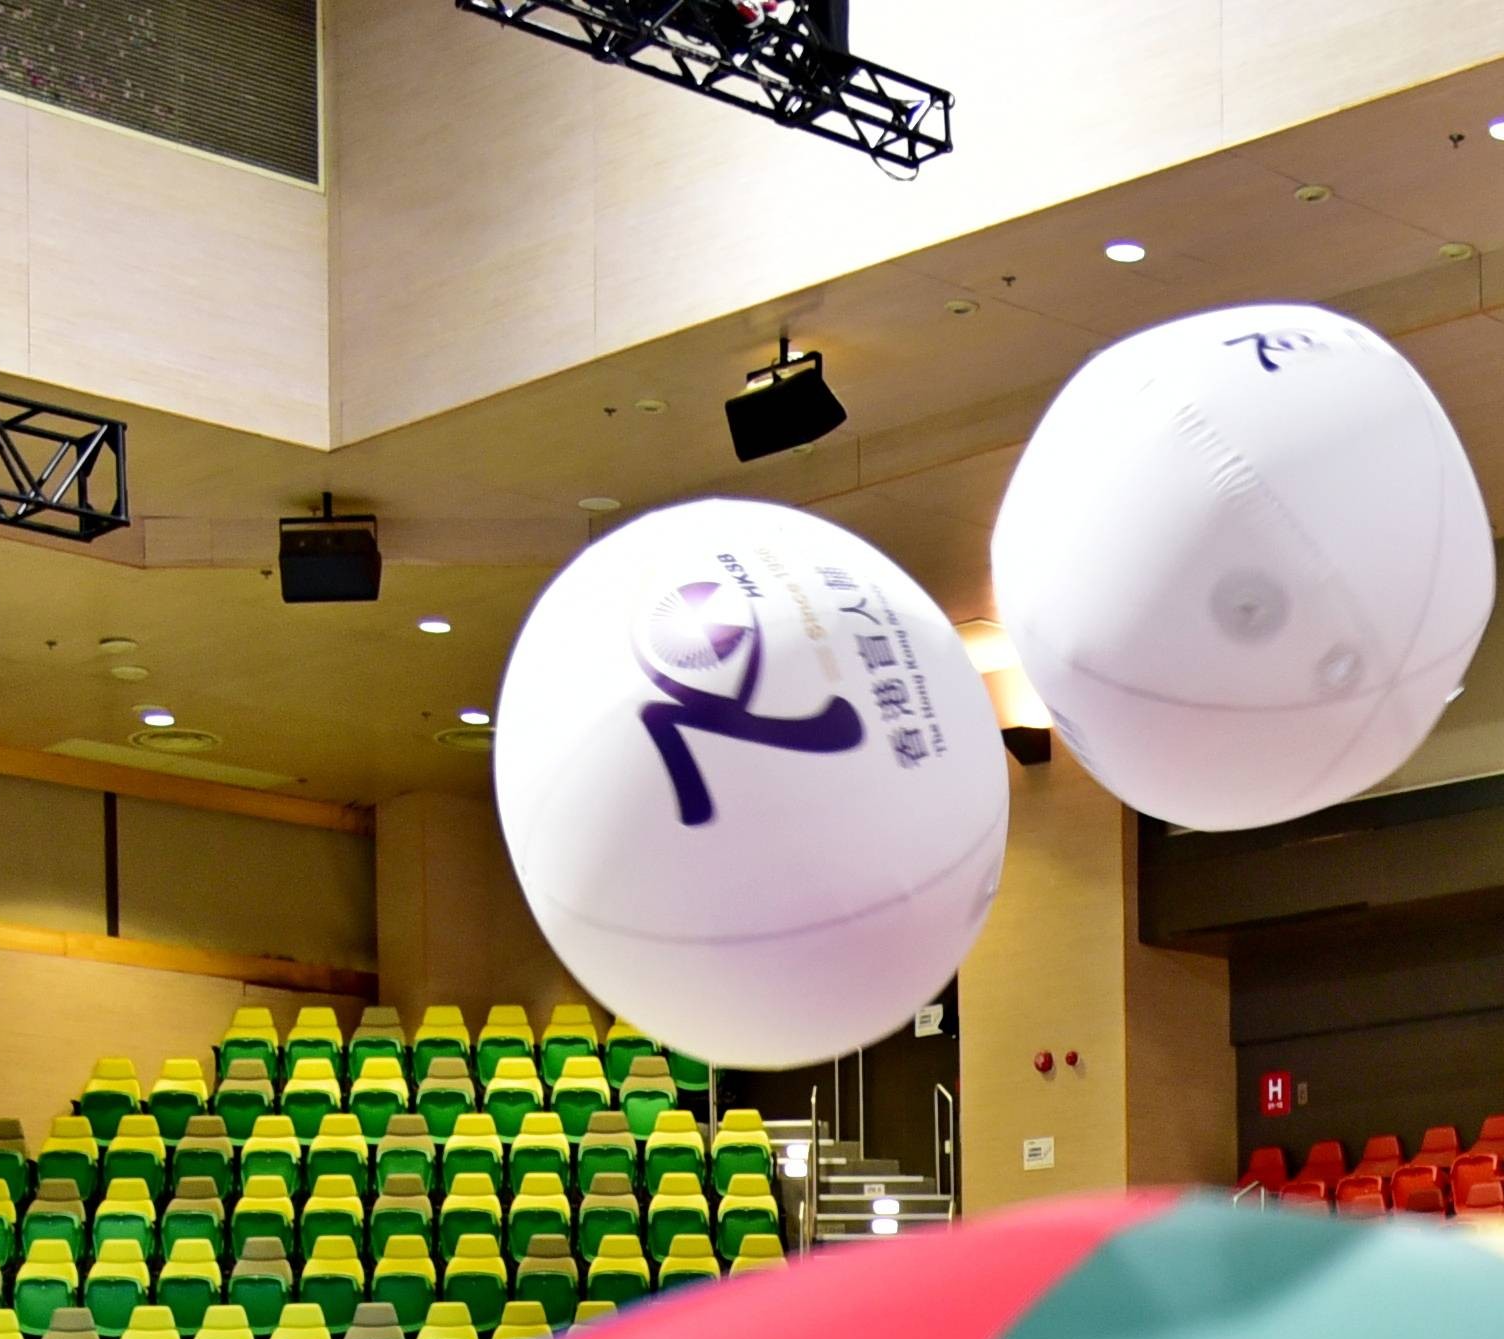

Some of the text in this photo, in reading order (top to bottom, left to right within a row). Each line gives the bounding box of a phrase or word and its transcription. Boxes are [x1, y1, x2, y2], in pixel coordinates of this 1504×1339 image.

[717, 553, 765, 599] HKSB
[913, 674, 936, 720] Hong
[1268, 1078, 1282, 1102] H
